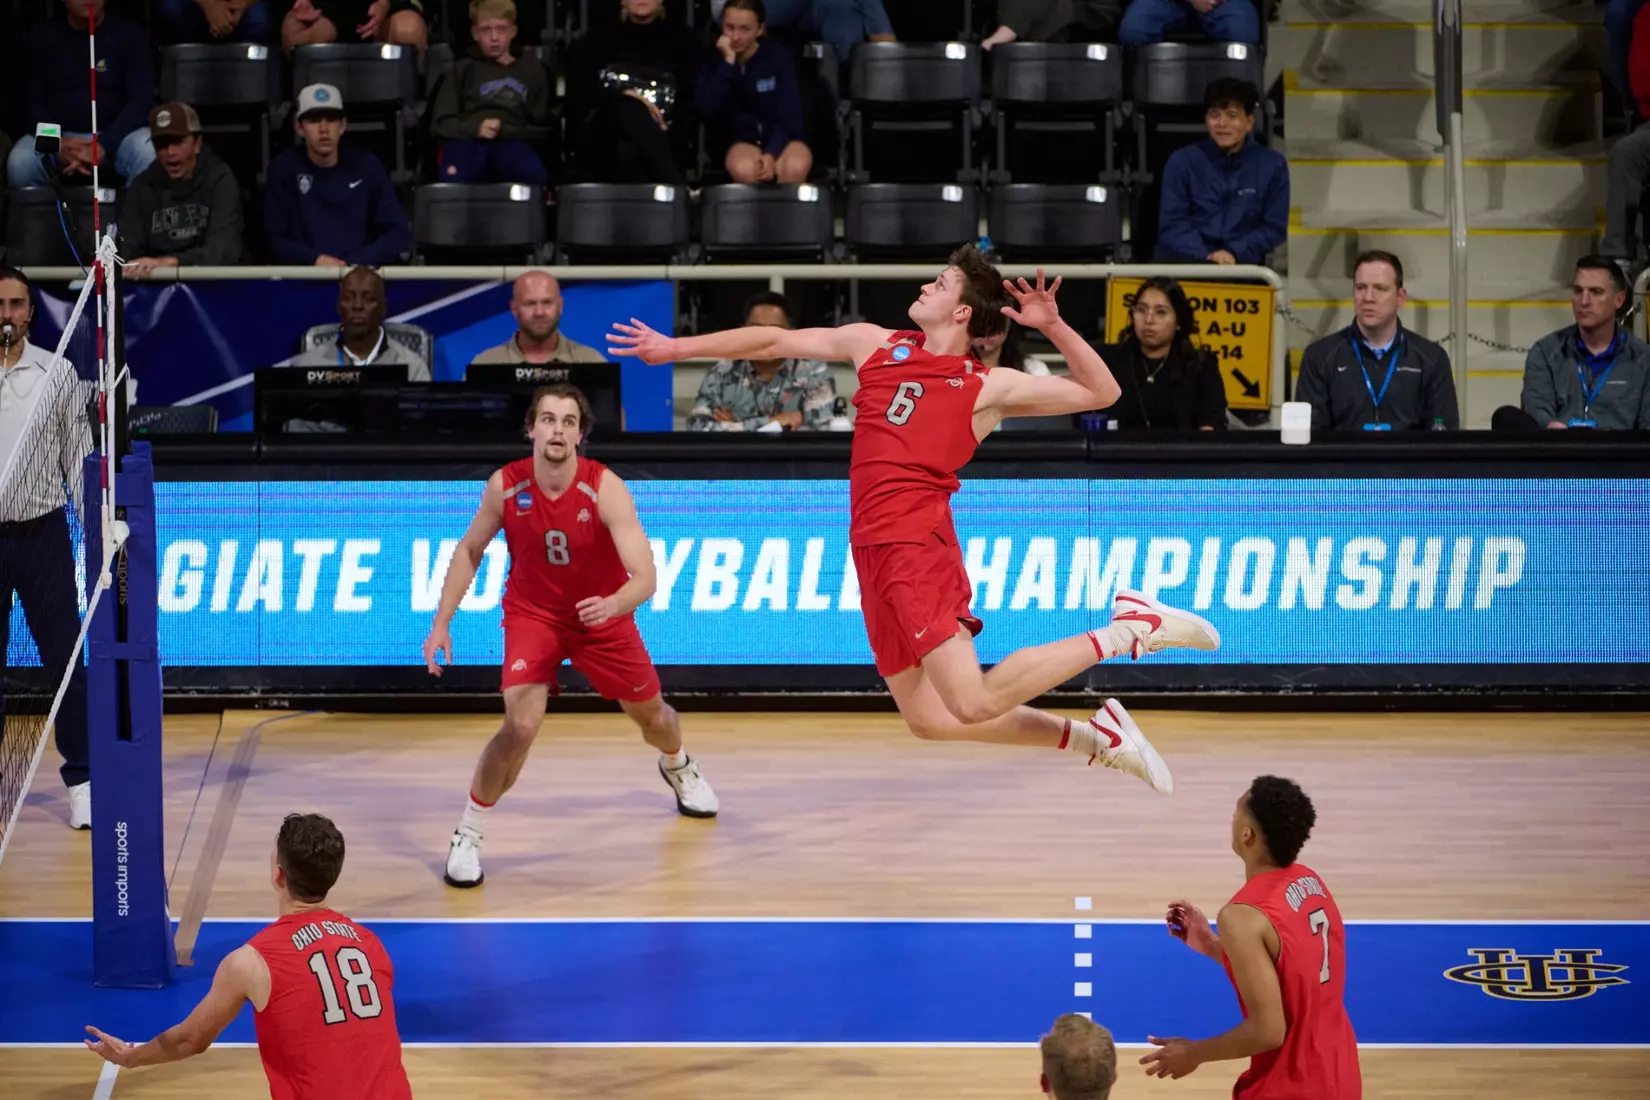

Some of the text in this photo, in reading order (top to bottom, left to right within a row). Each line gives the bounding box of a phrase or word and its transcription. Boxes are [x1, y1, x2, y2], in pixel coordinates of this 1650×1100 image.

[1206, 320, 1246, 337] A-U
[1224, 298, 1261, 314] 103
[885, 381, 925, 426] 6
[544, 529, 571, 566] 8
[158, 538, 381, 612] GIATE
[411, 537, 863, 612] VOYBALL
[962, 536, 1526, 610] HAMPIONSHIP
[115, 821, 130, 917] sports imports
[291, 920, 364, 952] OHIO STATE
[1308, 907, 1331, 985] 7
[307, 946, 383, 1026] 18
